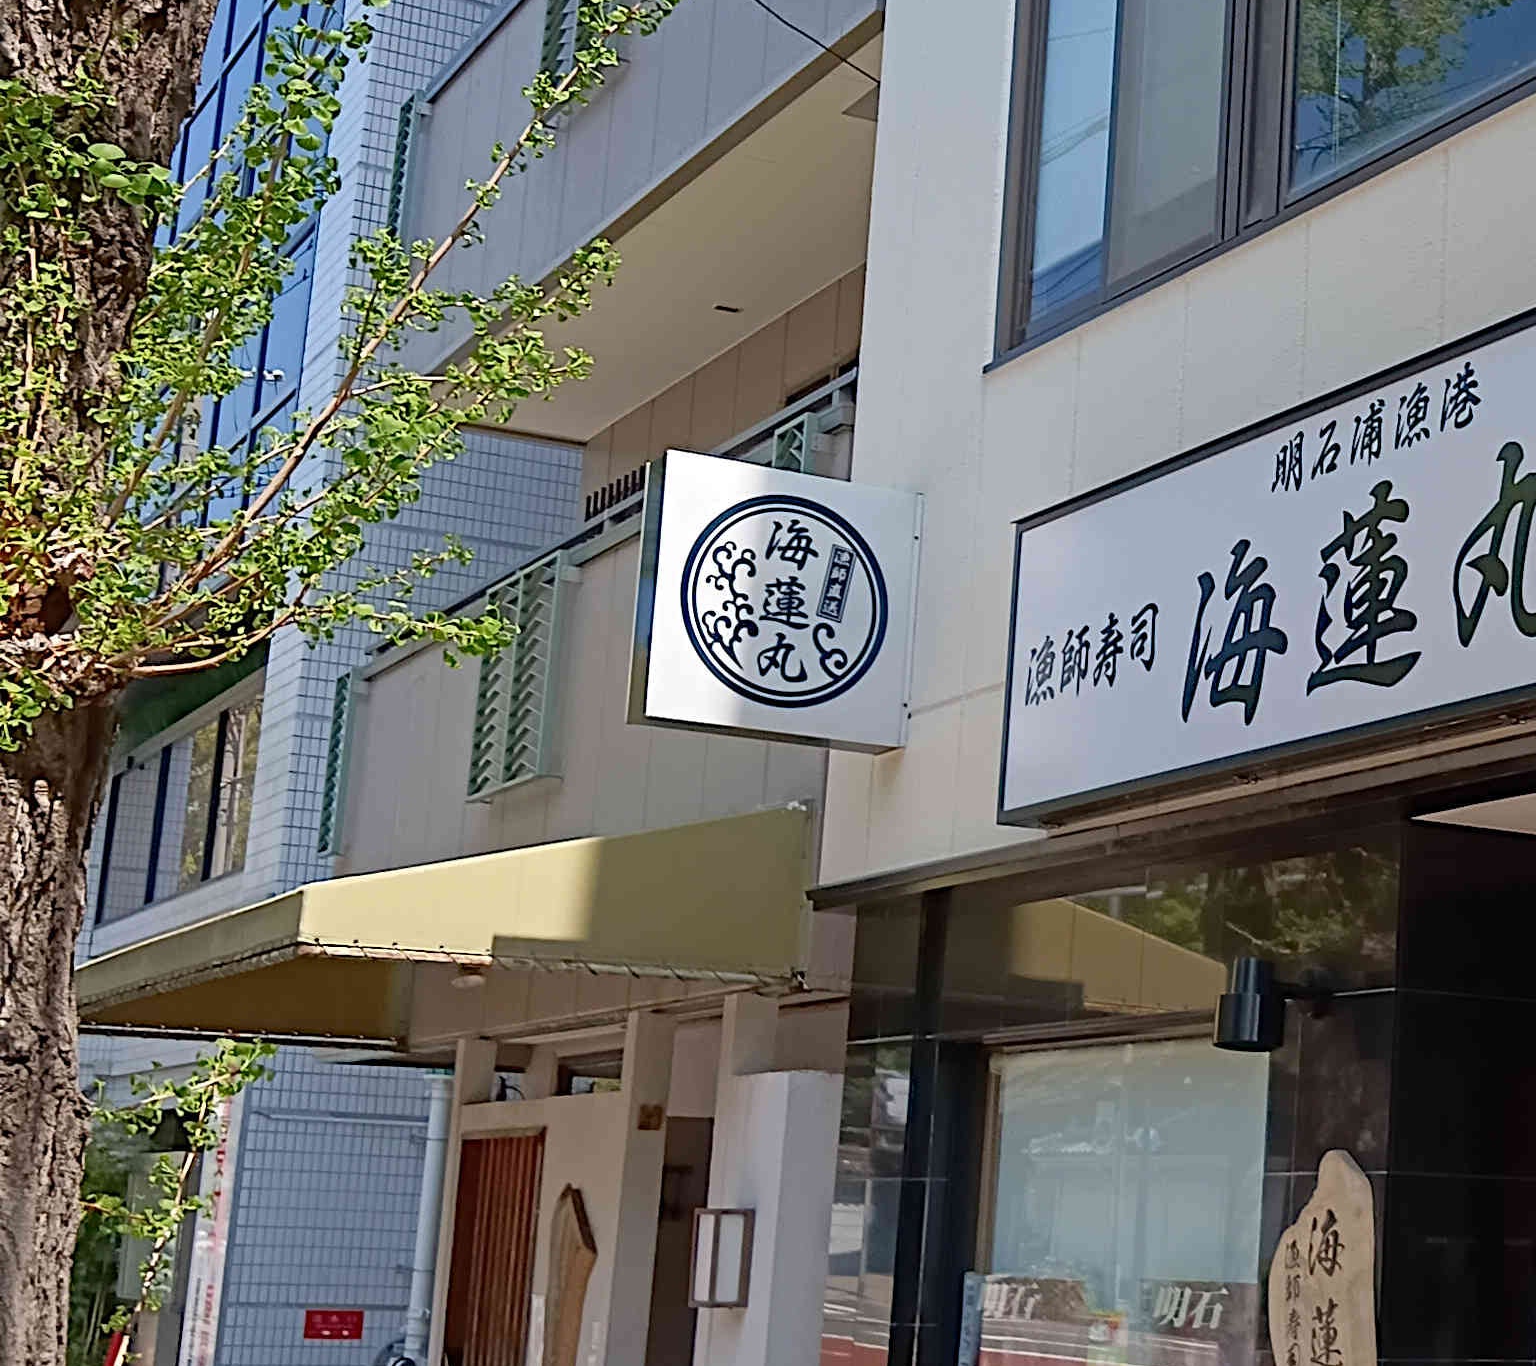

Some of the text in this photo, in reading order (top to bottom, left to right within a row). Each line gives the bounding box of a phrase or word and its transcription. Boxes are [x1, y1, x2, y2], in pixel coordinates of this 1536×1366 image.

[1271, 361, 1482, 493] 明石浦漁港
[757, 519, 819, 683] 海蓮丸
[1024, 602, 1159, 707] 漁師寿司
[1152, 1286, 1230, 1330] 明石
